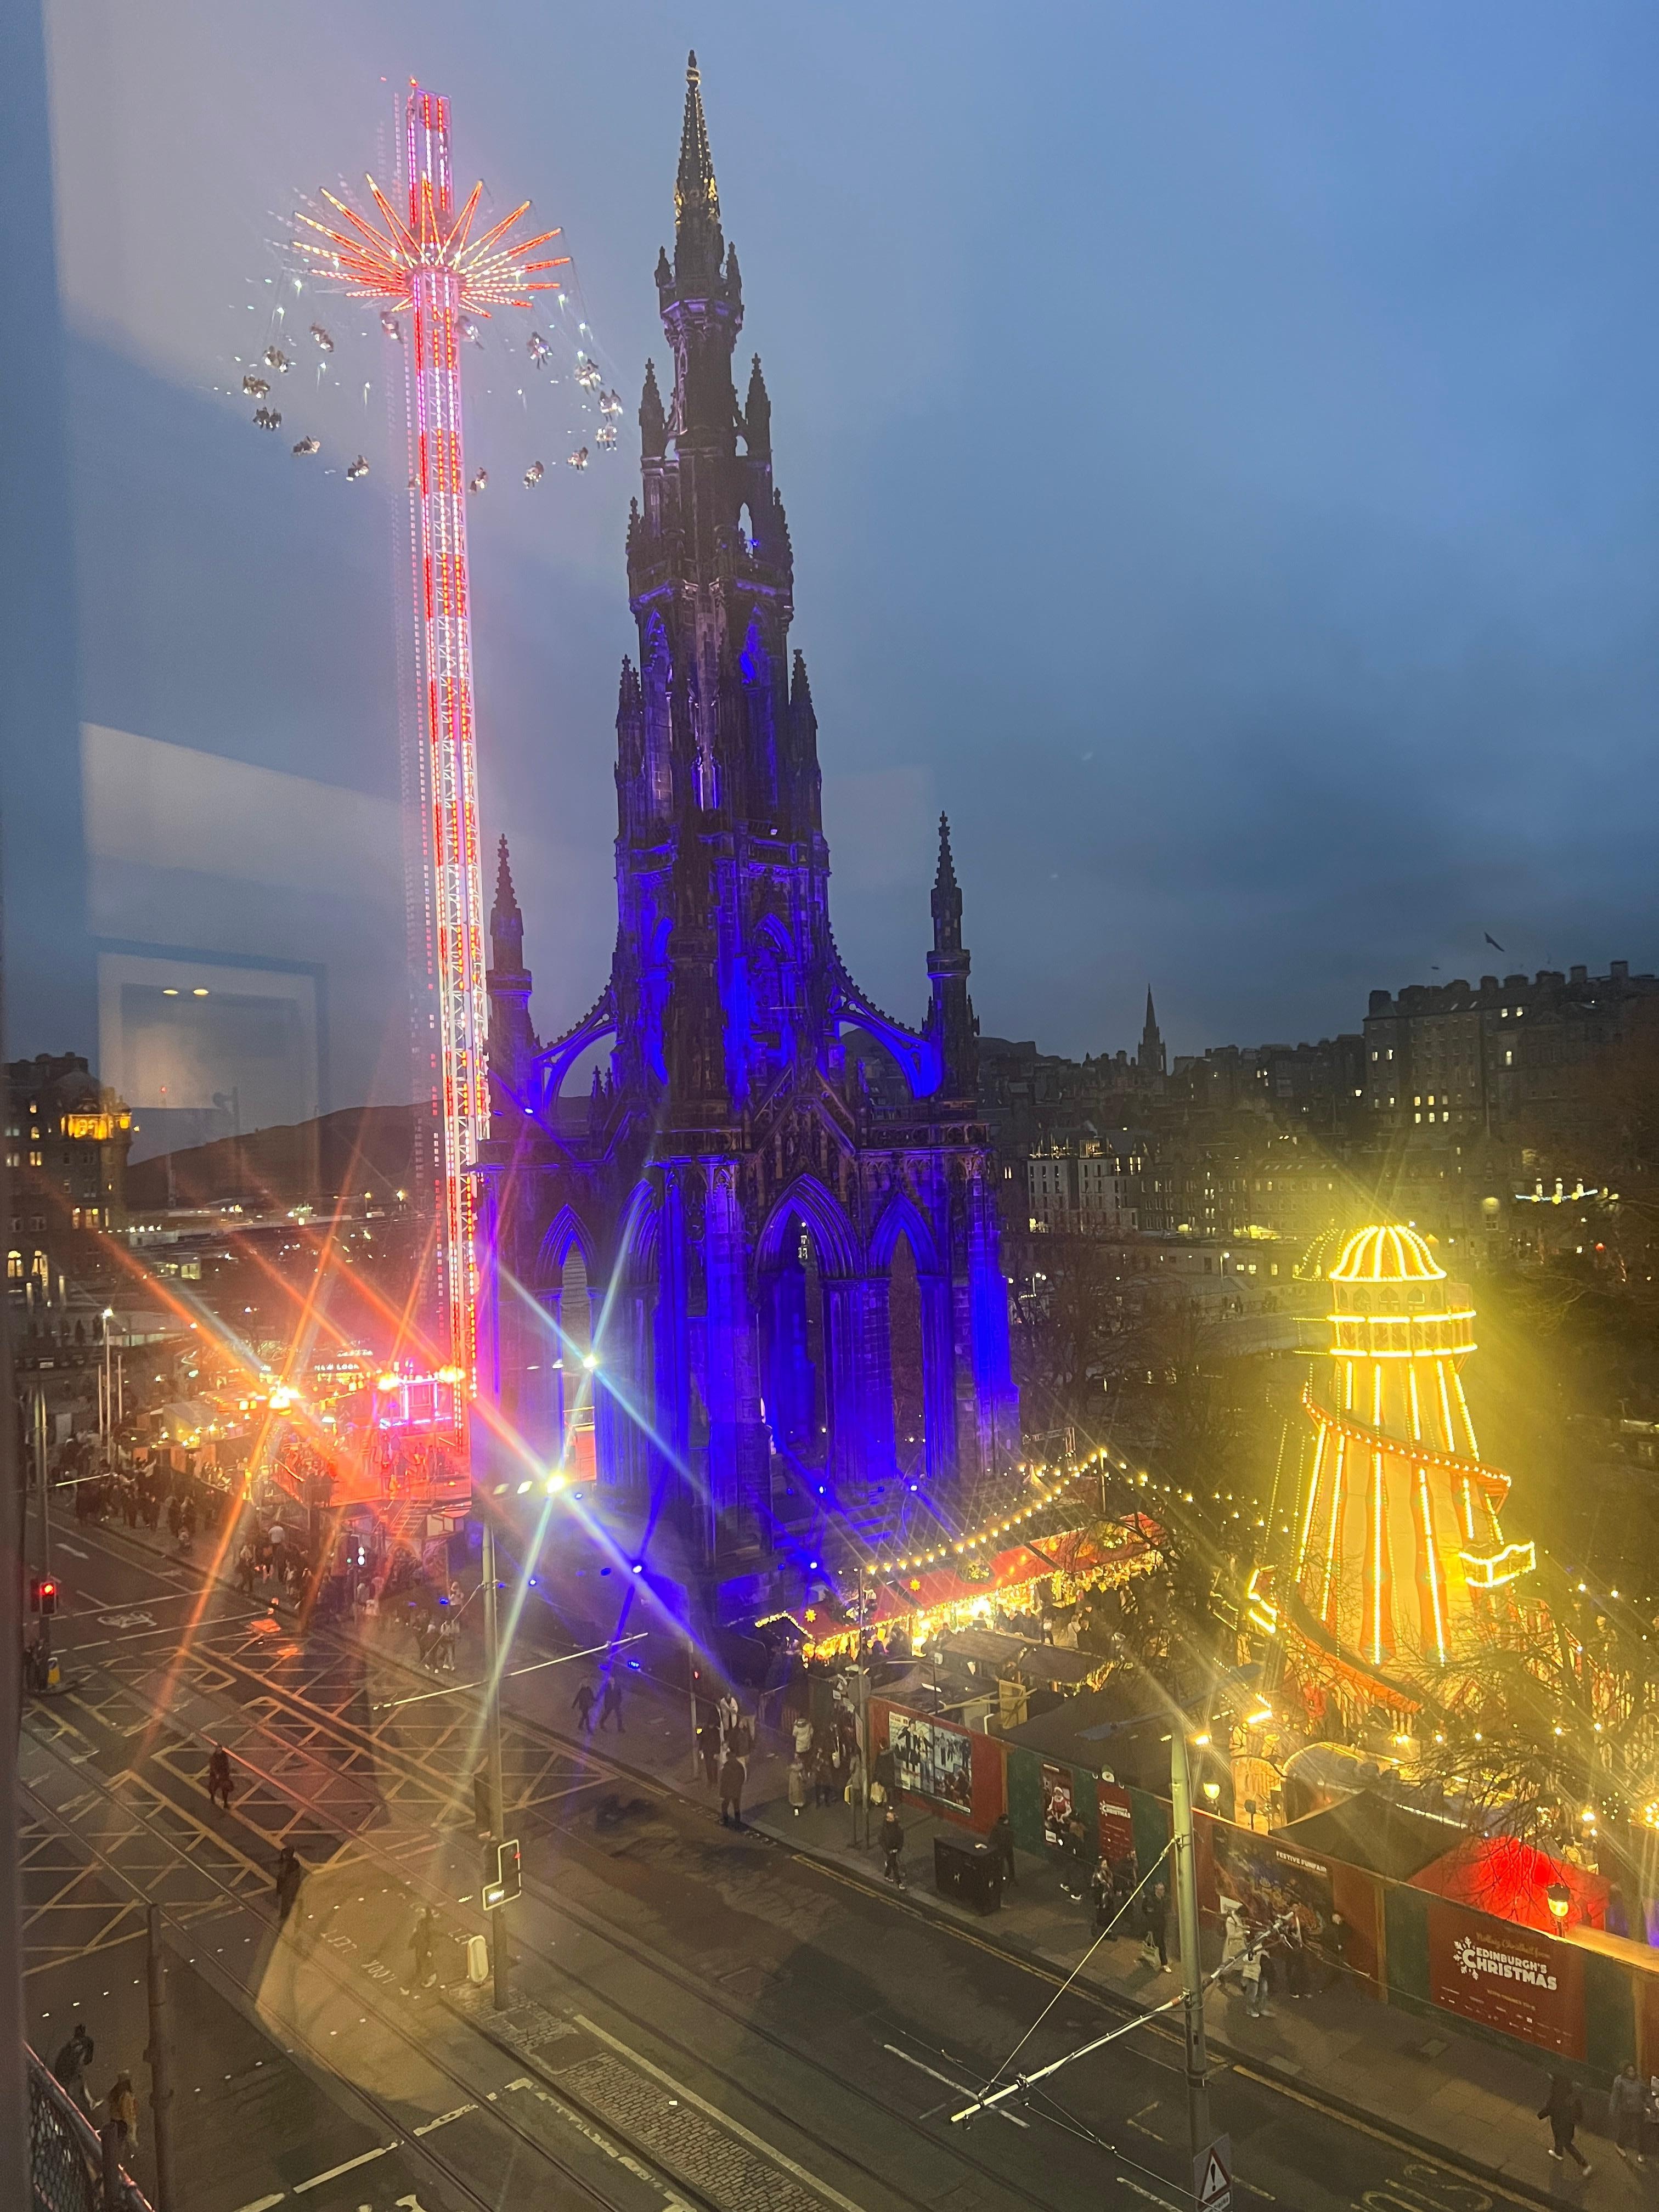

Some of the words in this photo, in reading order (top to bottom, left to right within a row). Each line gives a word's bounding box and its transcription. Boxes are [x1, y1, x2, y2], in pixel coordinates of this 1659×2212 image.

[1276, 1850, 1300, 1864] FESTIVE
[1462, 1949, 1558, 1991] CHRISTMAS
[1476, 1947, 1547, 1974] EDINBURGH'S
